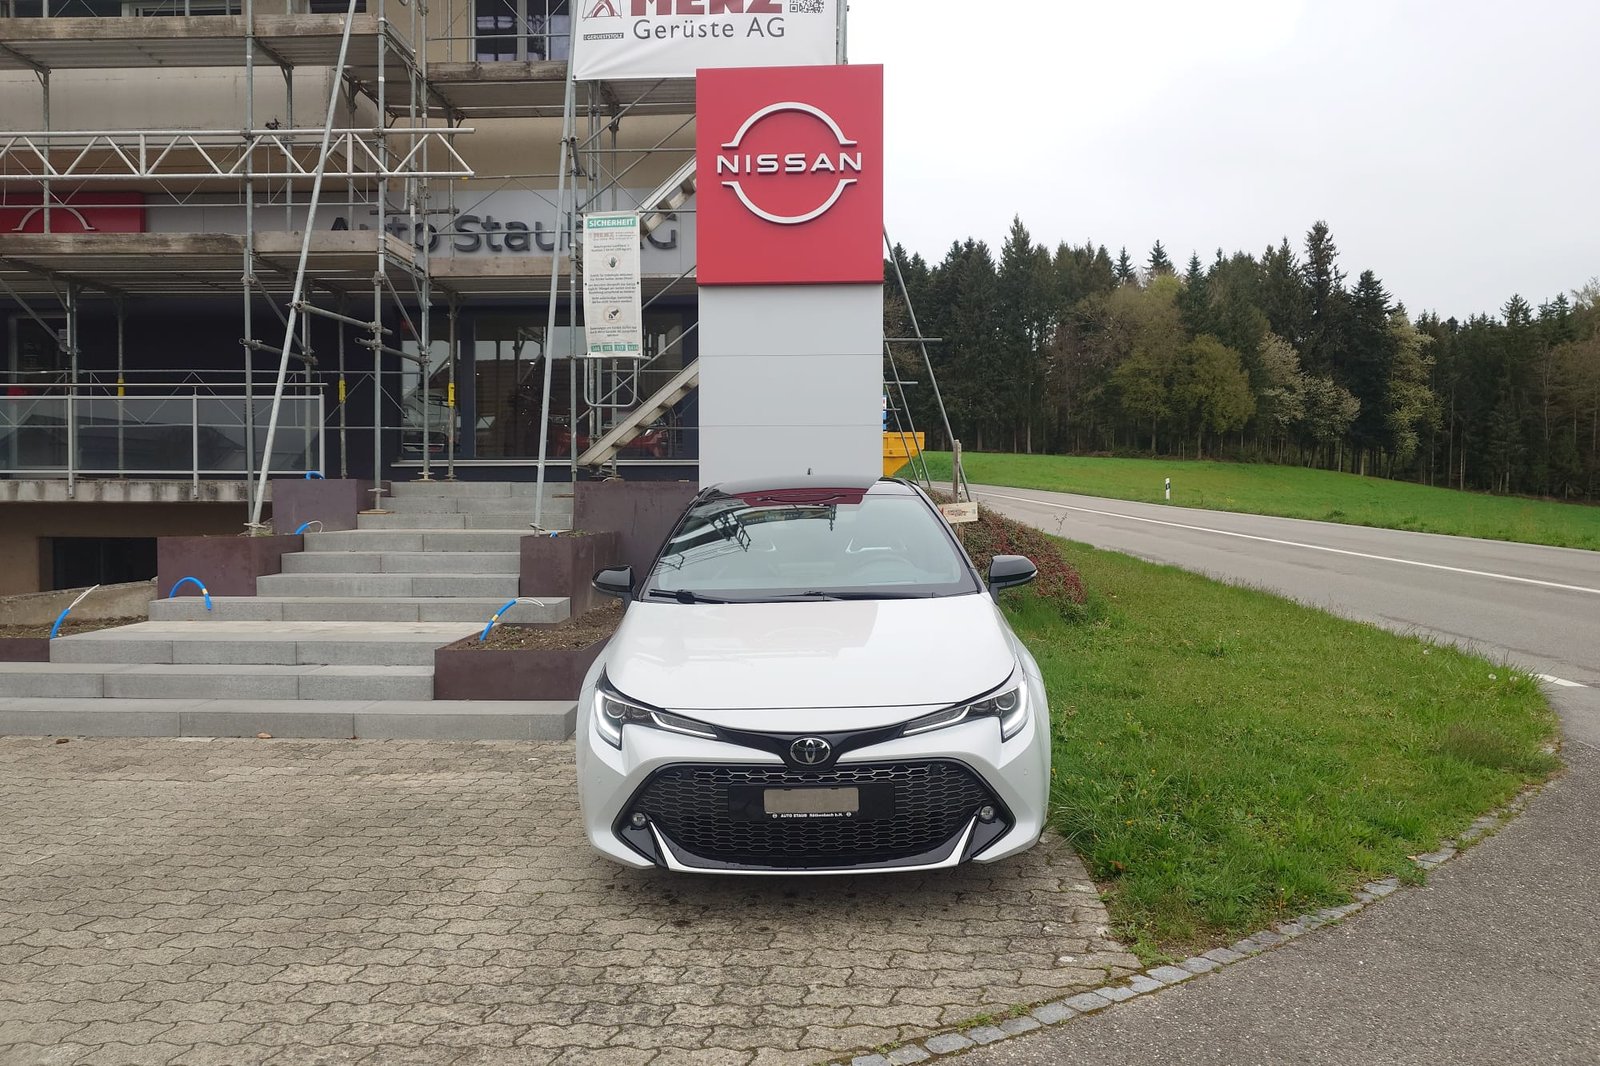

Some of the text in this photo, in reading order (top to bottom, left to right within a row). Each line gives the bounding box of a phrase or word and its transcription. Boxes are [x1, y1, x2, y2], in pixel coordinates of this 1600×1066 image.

[633, 17, 785, 39] Gerüste AG
[717, 152, 861, 174] NISSAN
[588, 218, 634, 228] SICHERHEIT
